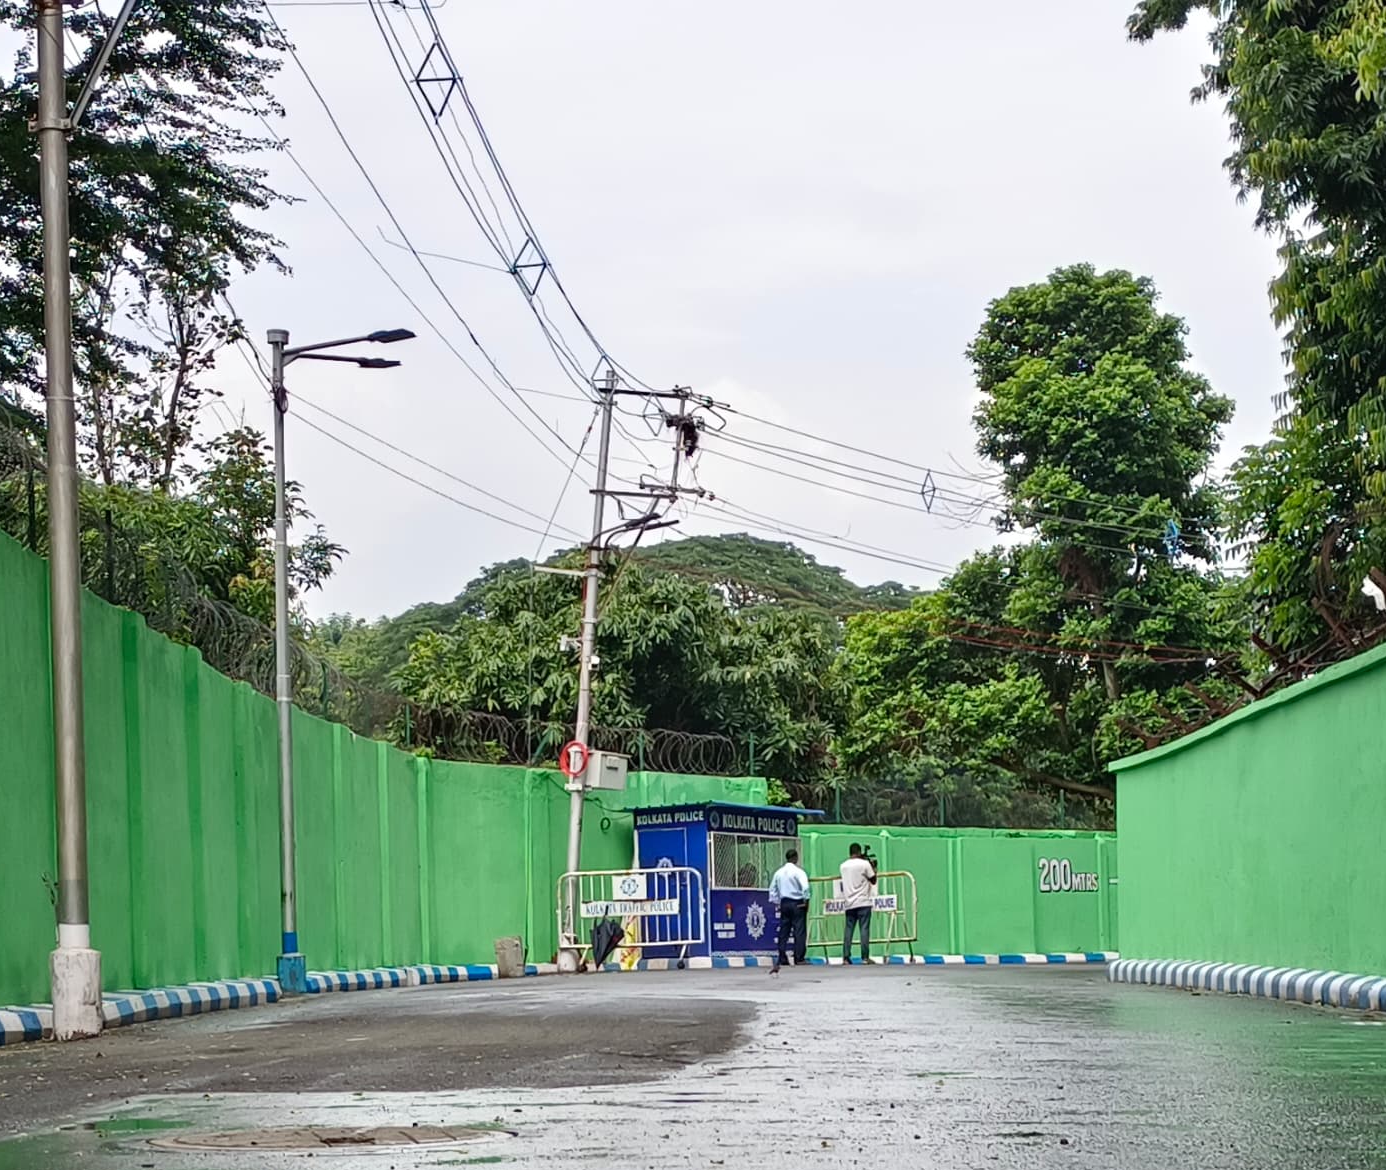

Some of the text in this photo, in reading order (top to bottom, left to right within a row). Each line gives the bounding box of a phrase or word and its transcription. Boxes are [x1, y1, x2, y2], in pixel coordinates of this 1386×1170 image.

[636, 811, 704, 825] KOLKATA POLICE
[722, 814, 785, 833] KOLKATA POLICE
[650, 901, 674, 913] POLICE
[874, 898, 895, 909] POLICE
